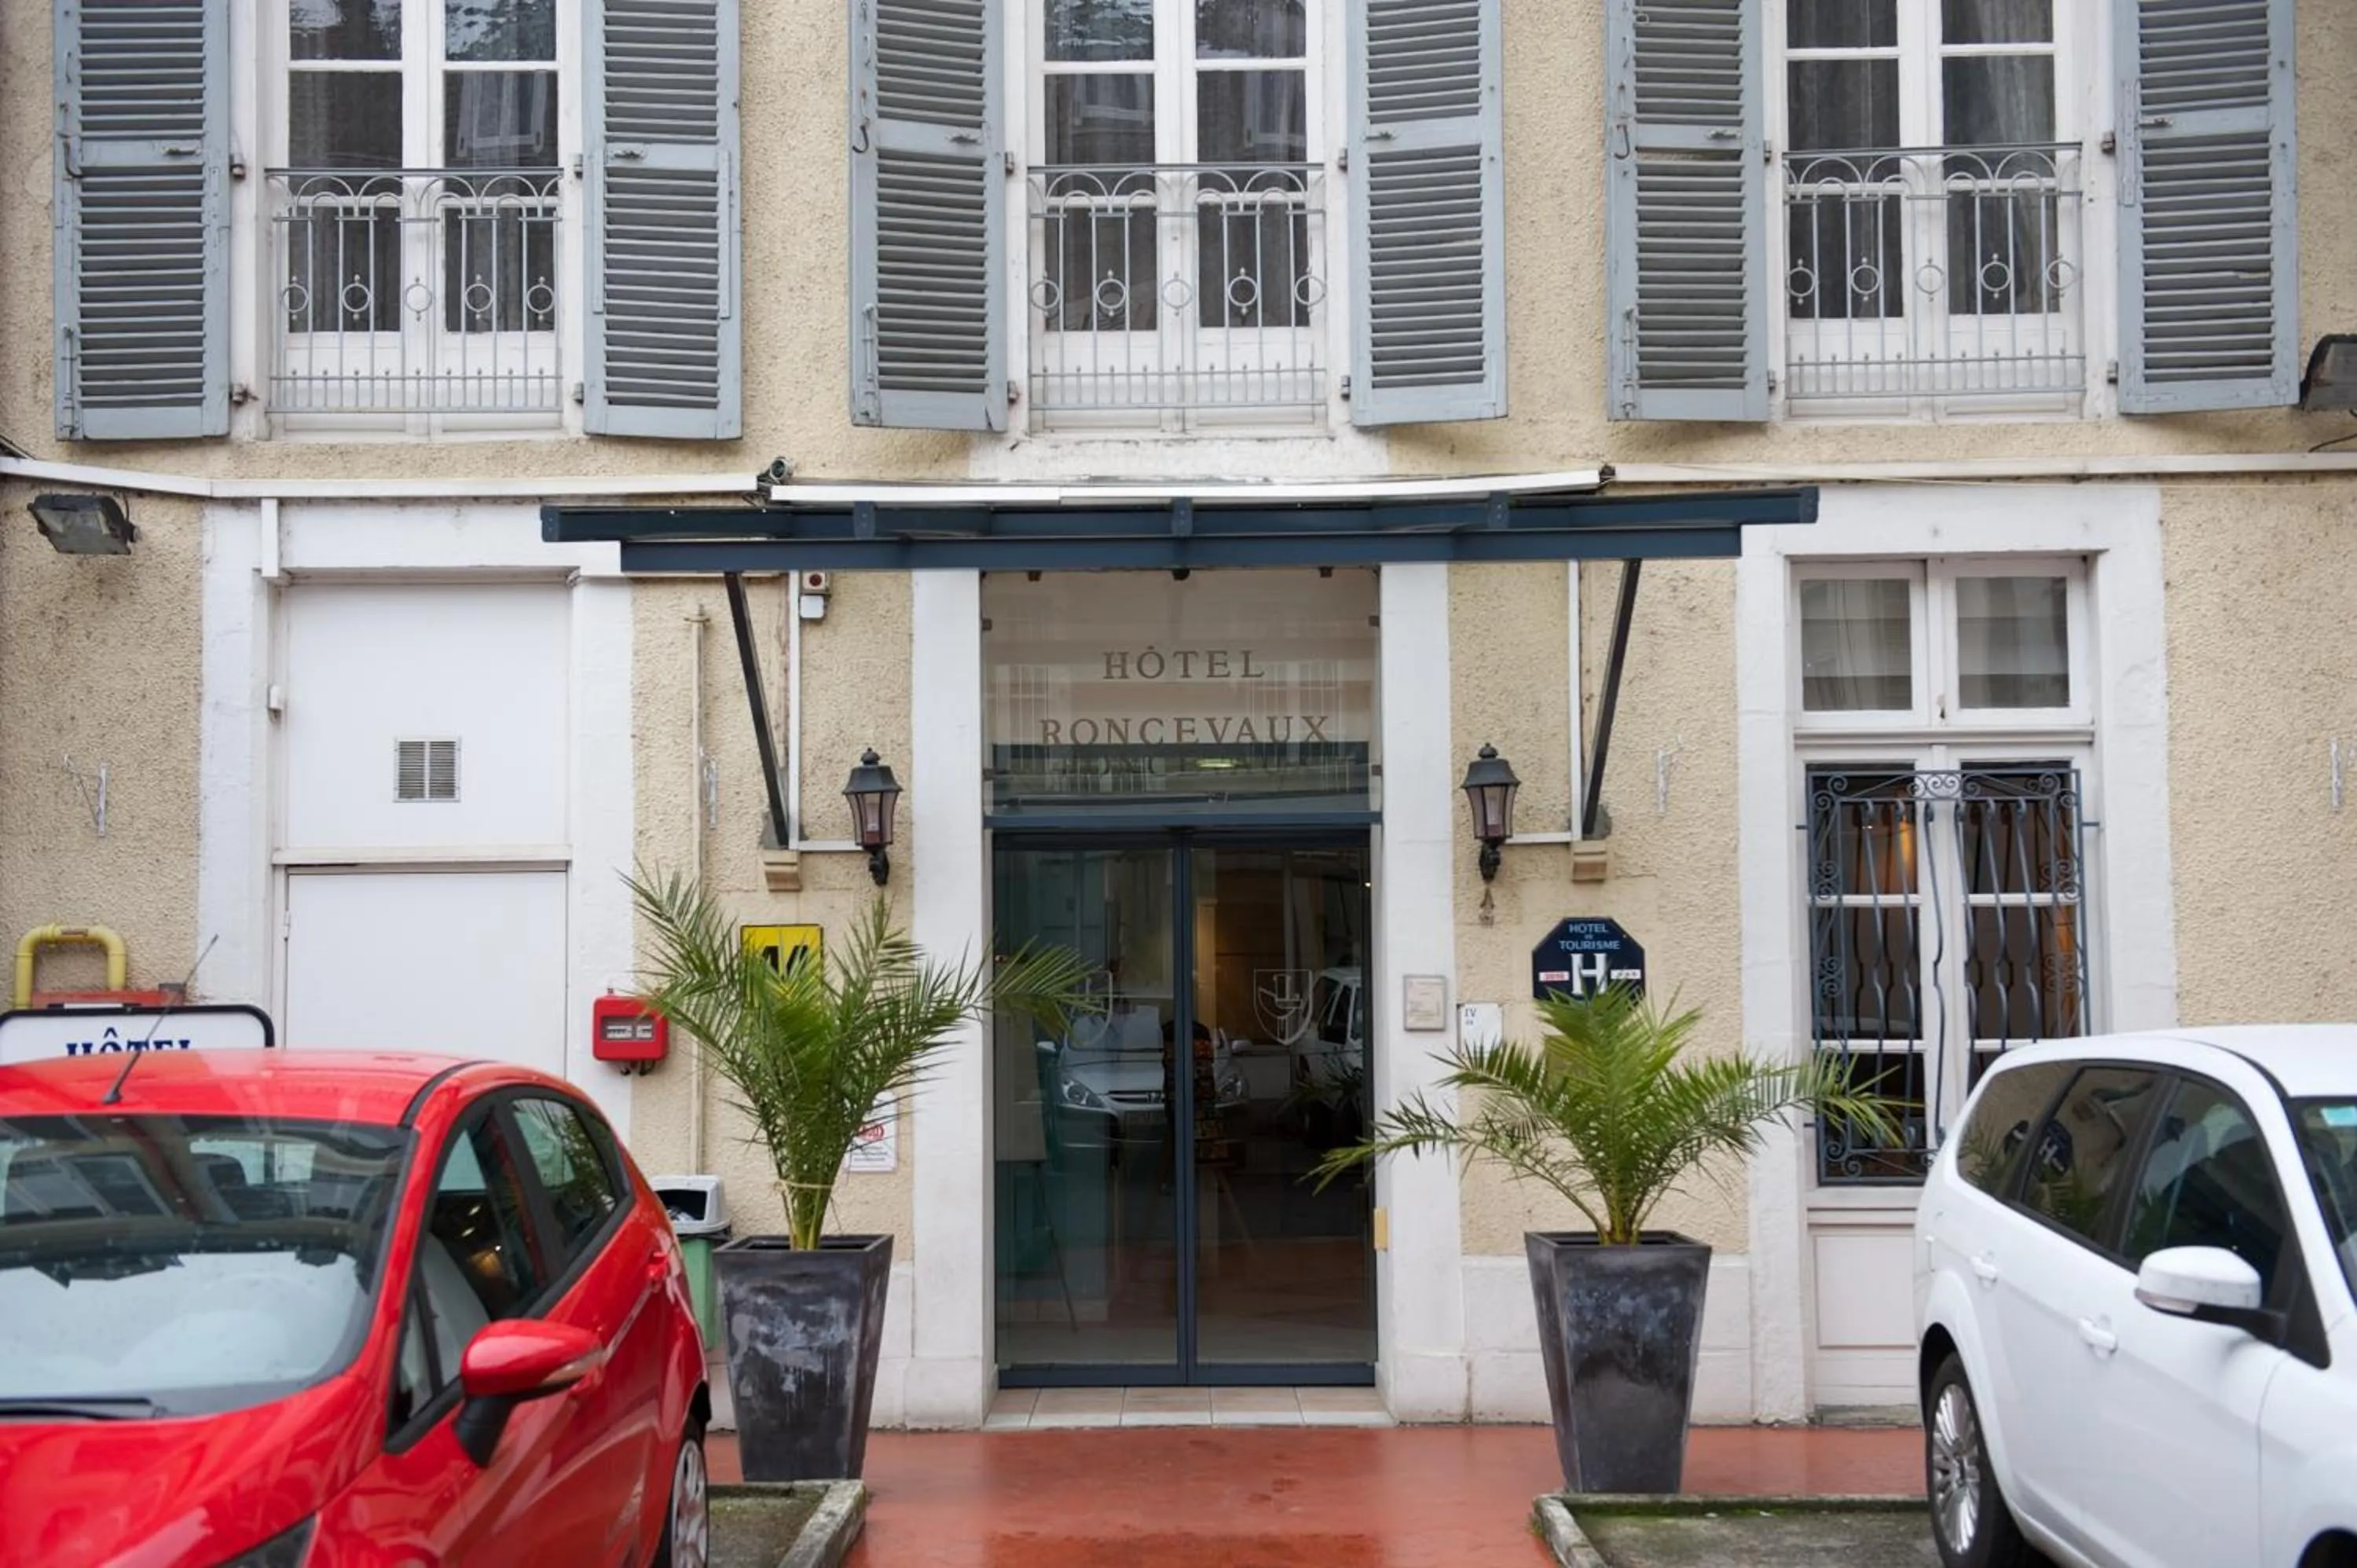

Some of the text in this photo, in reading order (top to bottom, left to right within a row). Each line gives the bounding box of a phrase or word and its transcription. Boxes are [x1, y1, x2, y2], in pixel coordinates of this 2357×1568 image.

[1103, 645, 1265, 679] HÔTEL
[1040, 716, 1329, 746] RONCEVAUX
[1569, 923, 1608, 933] HOTEL
[1559, 940, 1620, 950] TOURISME
[1571, 953, 1607, 995] H
